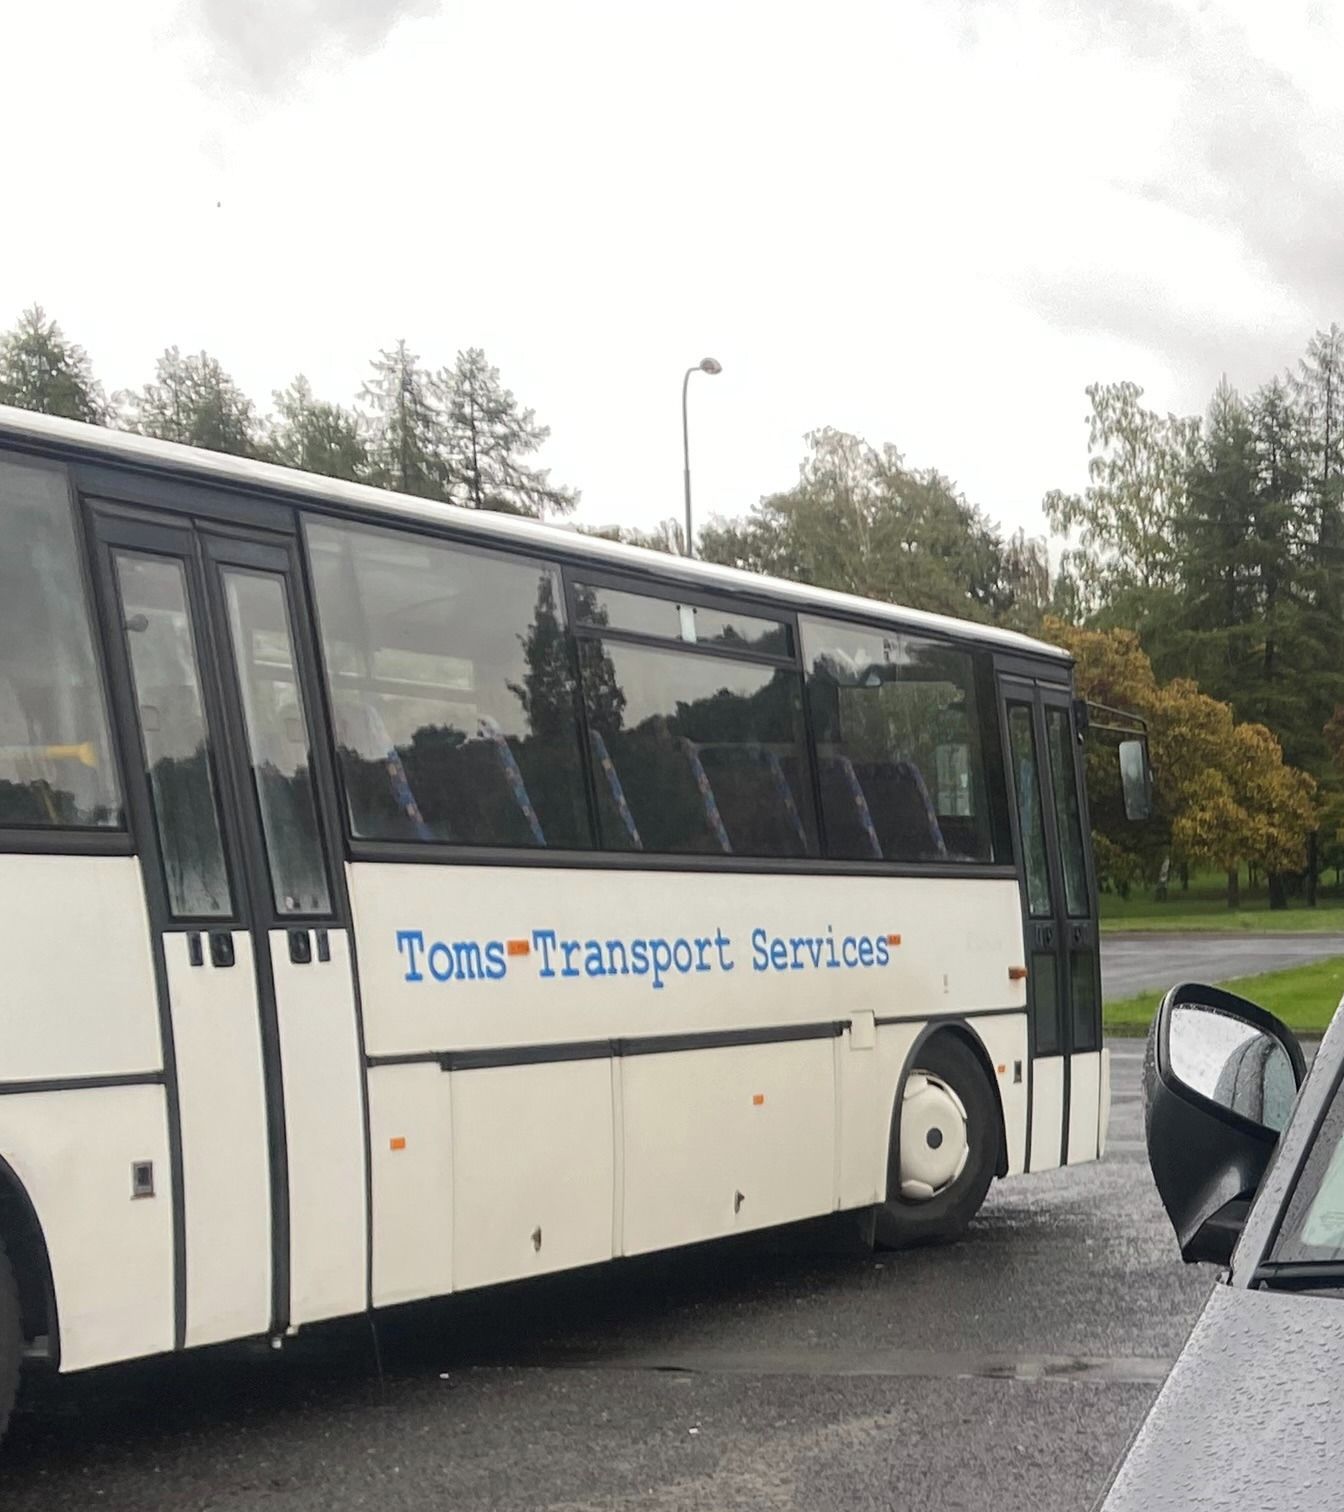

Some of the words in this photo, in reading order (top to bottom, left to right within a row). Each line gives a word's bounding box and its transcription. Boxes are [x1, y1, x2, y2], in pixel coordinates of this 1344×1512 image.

[396, 930, 507, 981] Toms
[531, 928, 735, 988] Transport
[751, 925, 892, 972] Services
